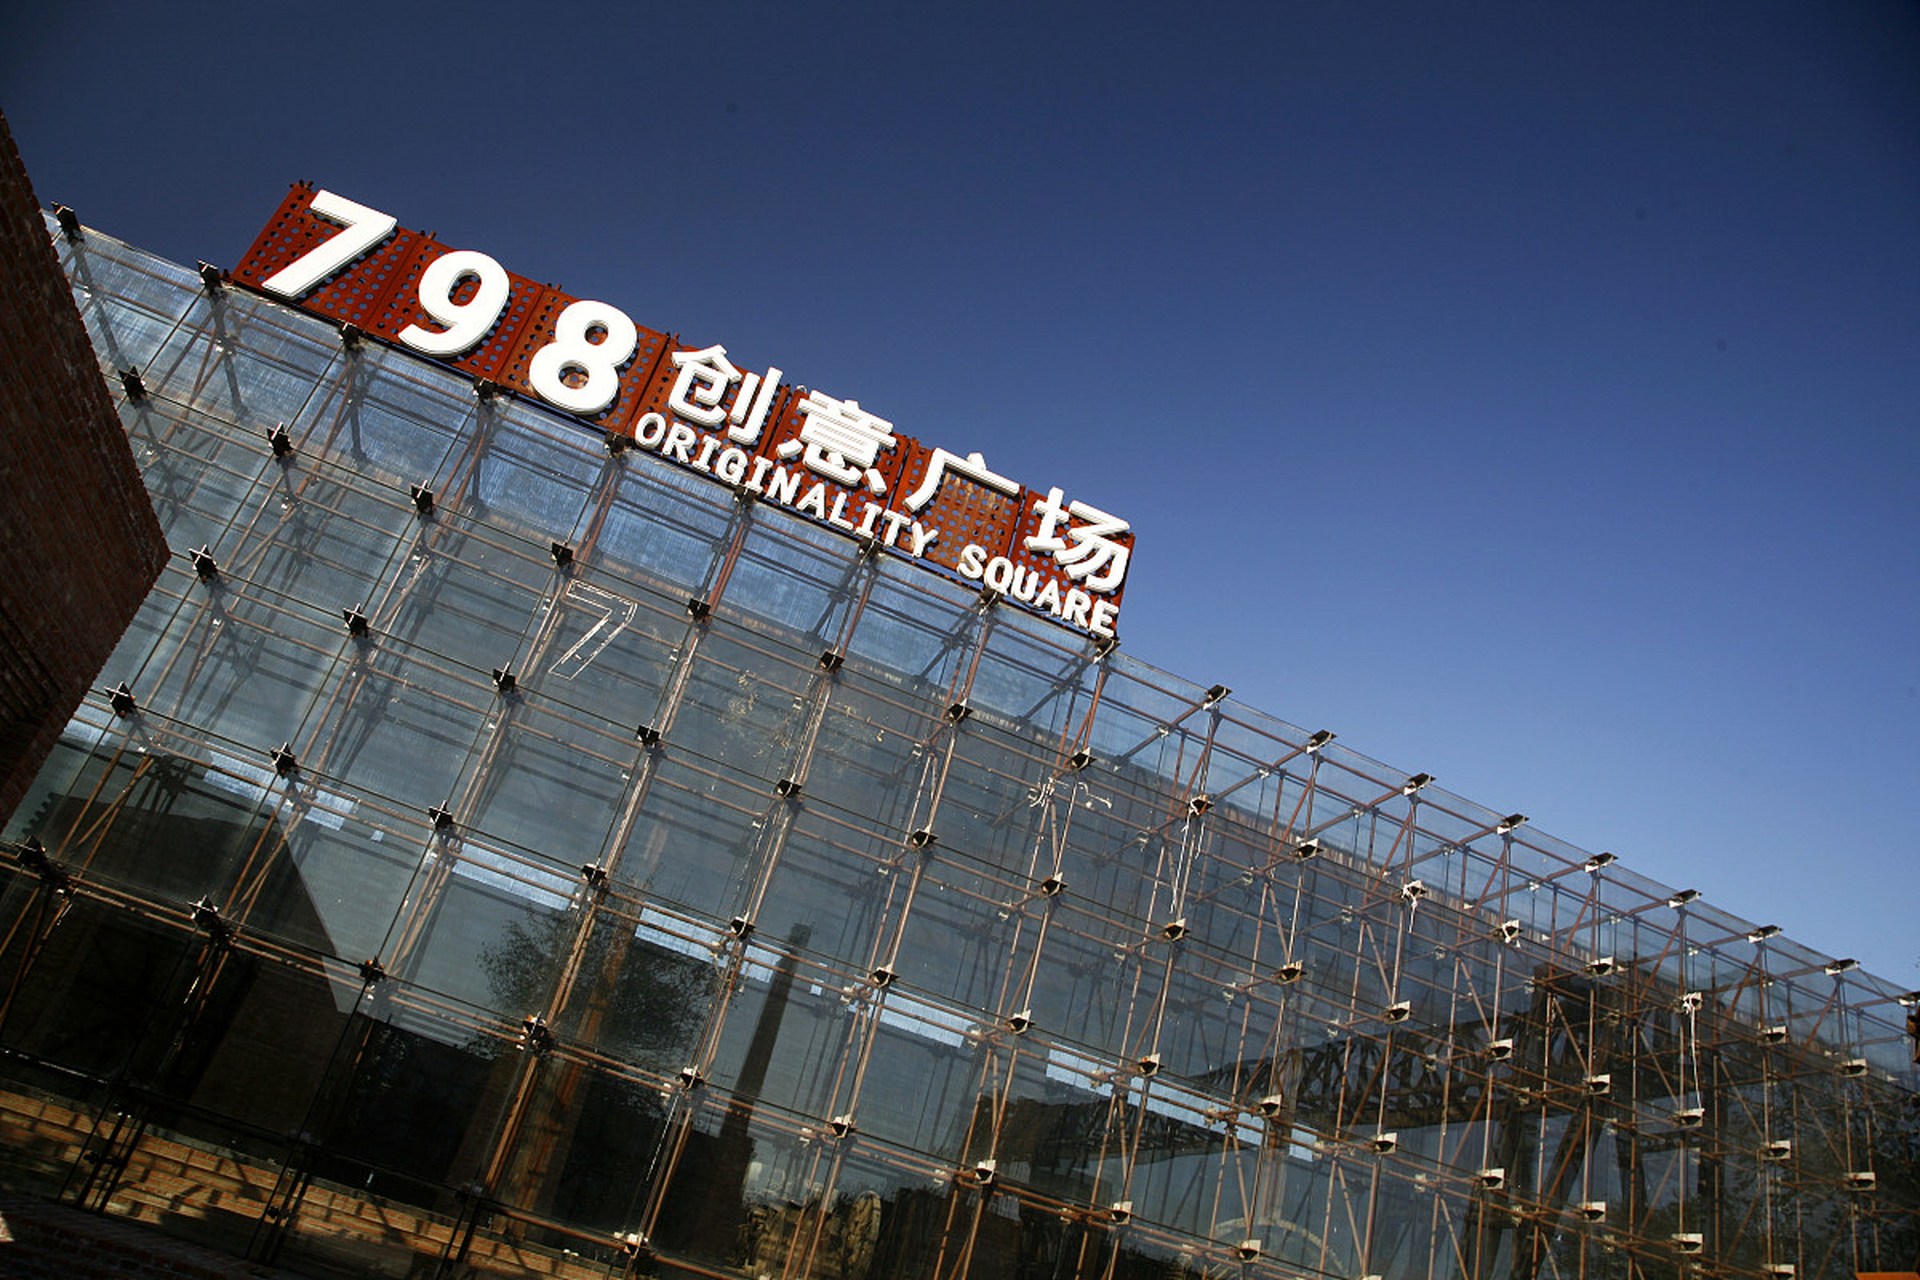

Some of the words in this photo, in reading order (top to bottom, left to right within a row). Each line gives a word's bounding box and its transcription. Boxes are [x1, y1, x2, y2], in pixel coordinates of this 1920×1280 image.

[262, 189, 638, 413] 798
[668, 344, 1130, 592] 创意广场
[548, 578, 638, 681] 7
[634, 412, 939, 558] ORIGINALITY
[956, 544, 1120, 638] SQUARE
